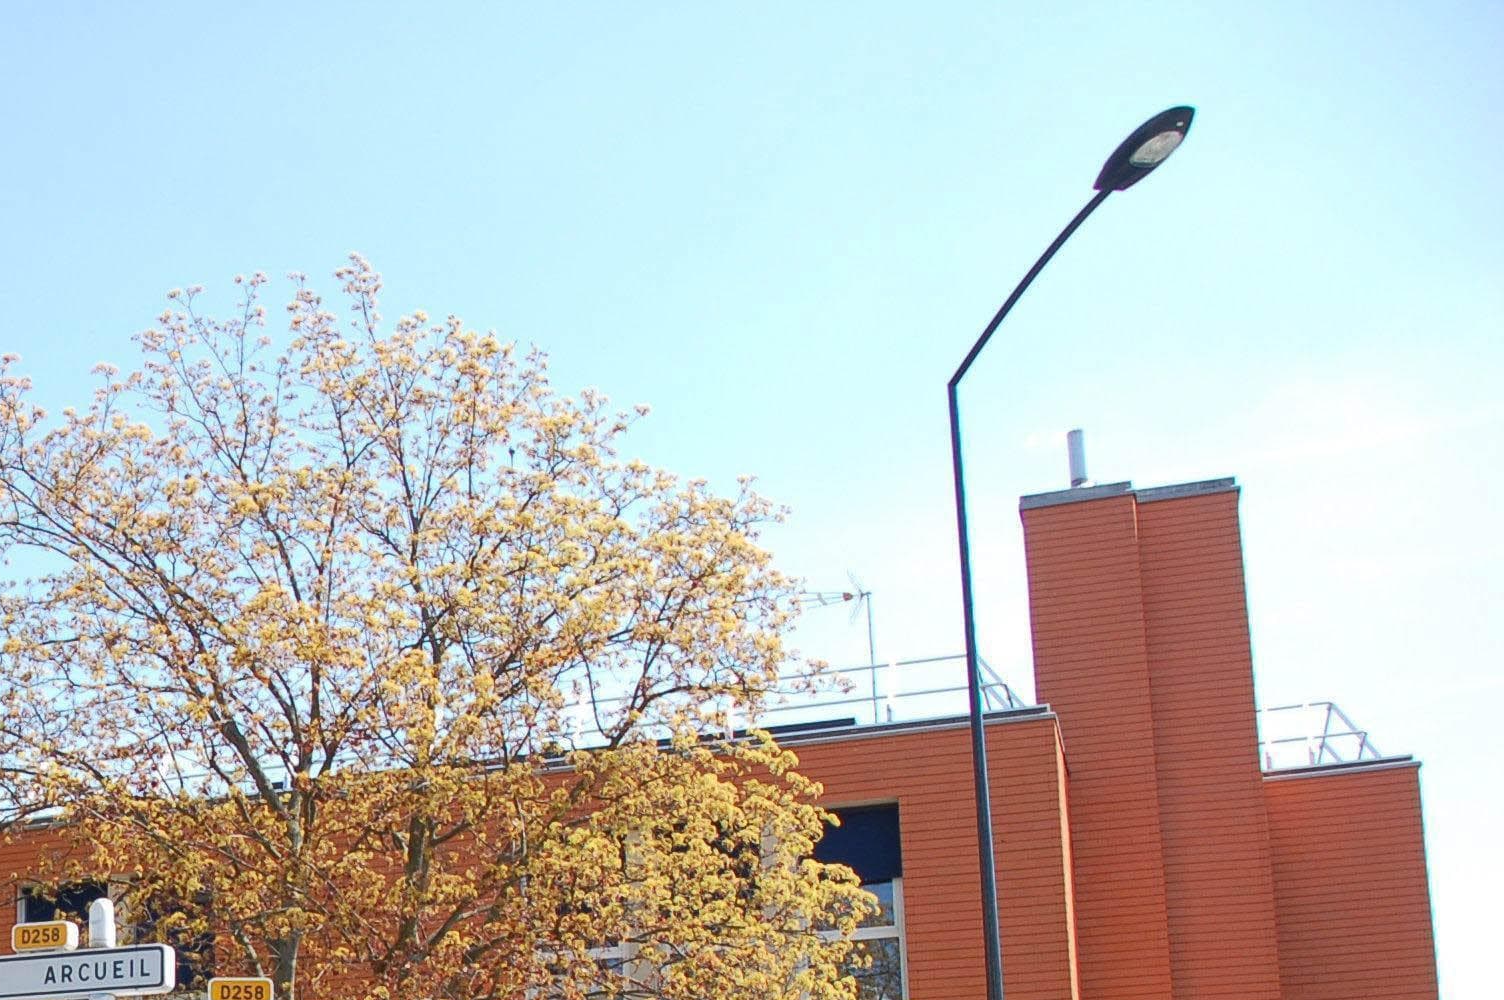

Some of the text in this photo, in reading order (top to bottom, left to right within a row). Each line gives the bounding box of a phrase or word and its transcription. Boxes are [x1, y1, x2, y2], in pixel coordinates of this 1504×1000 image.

[21, 926, 60, 944] D258
[44, 958, 152, 985] ARCUEIL
[219, 983, 264, 1000] D258
